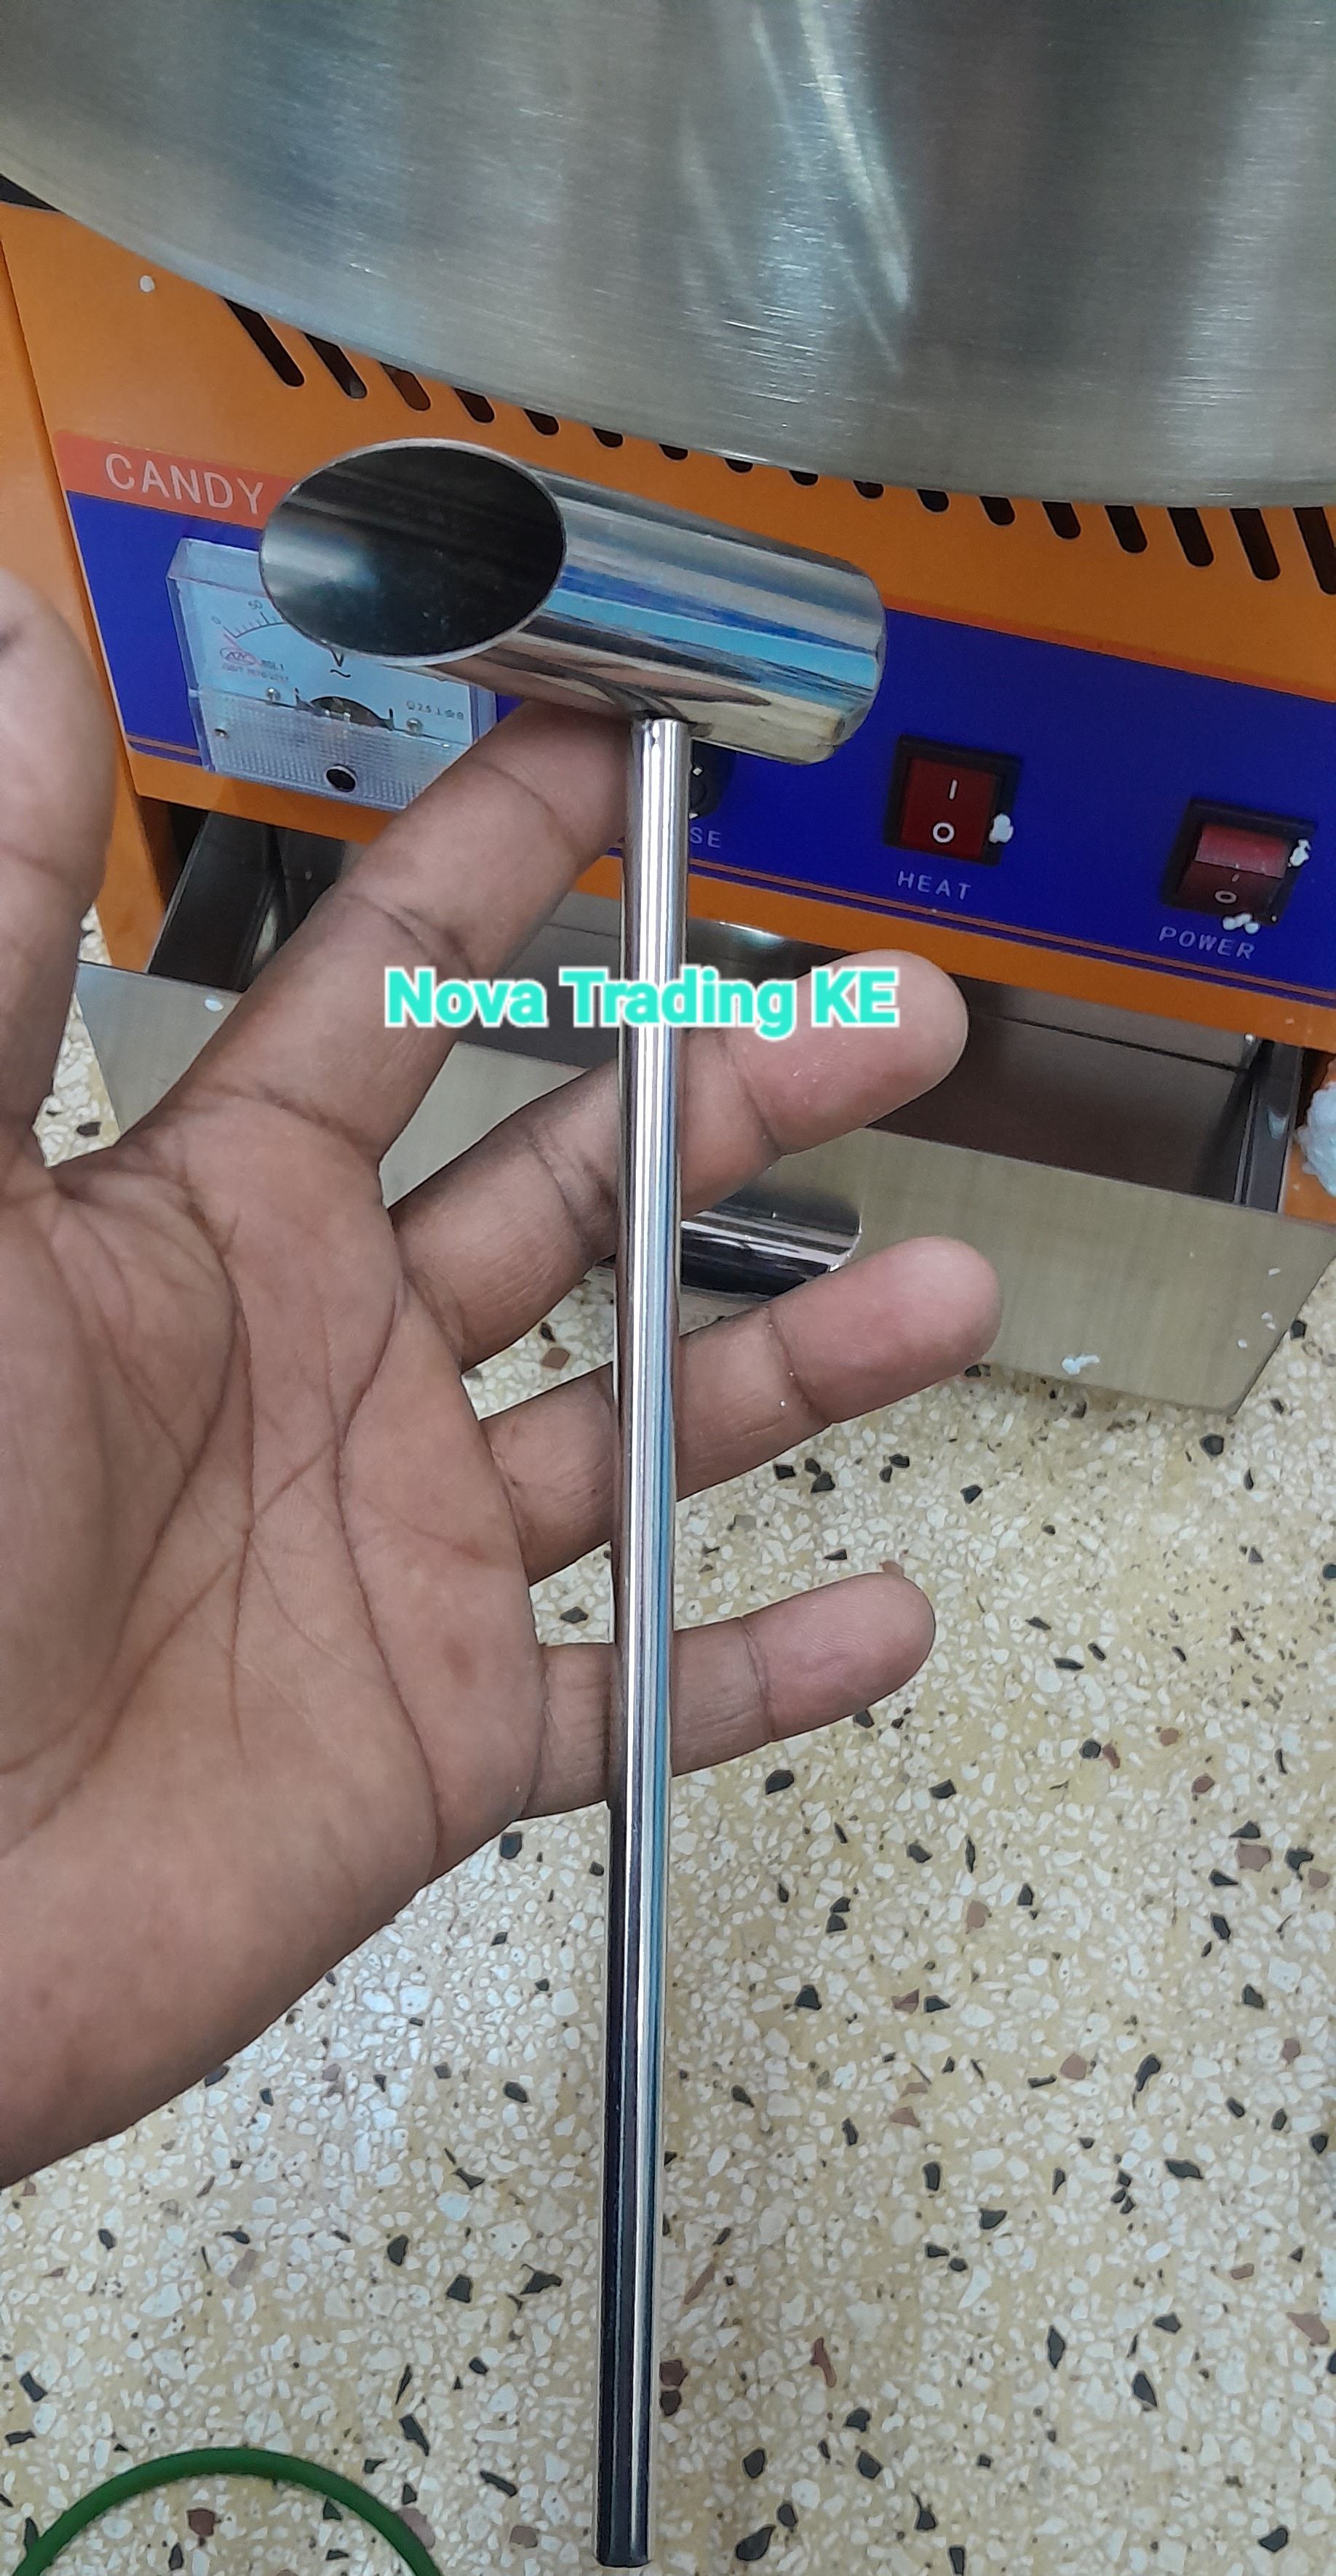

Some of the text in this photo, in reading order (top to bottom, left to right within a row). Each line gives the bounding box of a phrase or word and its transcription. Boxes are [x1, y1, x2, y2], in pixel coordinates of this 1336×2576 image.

[105, 452, 264, 515] CANDY
[689, 826, 722, 849] SE
[897, 870, 971, 901] HEAT
[1158, 925, 1255, 960] POWER
